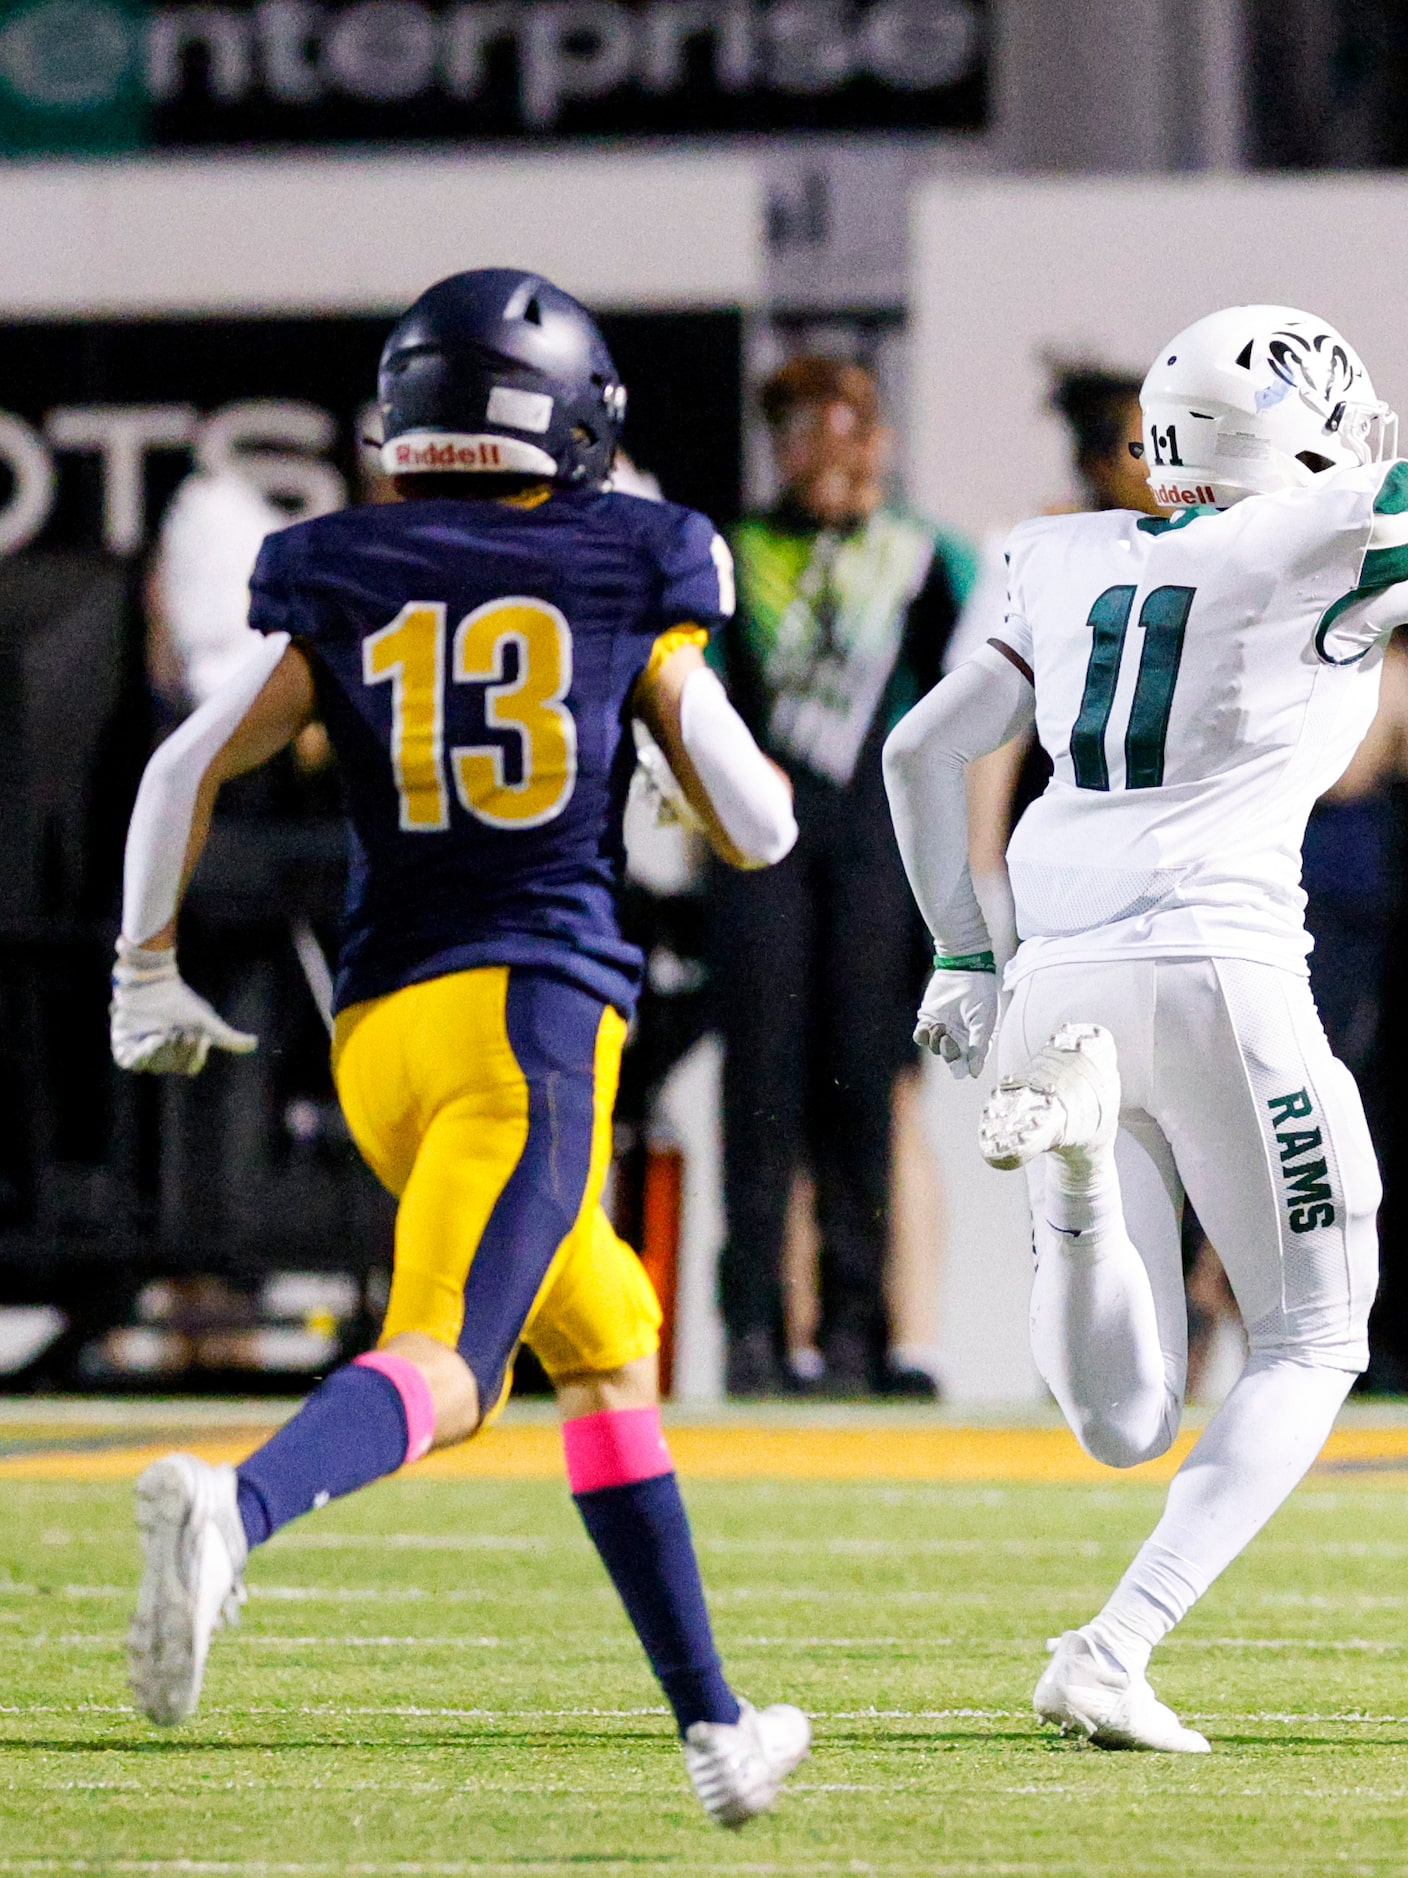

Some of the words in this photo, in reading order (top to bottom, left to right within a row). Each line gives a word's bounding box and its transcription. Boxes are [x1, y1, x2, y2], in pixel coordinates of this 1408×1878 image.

[396, 443, 499, 465] Riddell
[1153, 484, 1216, 504] iddell
[362, 595, 577, 832] 13
[1070, 584, 1197, 791] 11
[1267, 1086, 1335, 1234] RAMS
